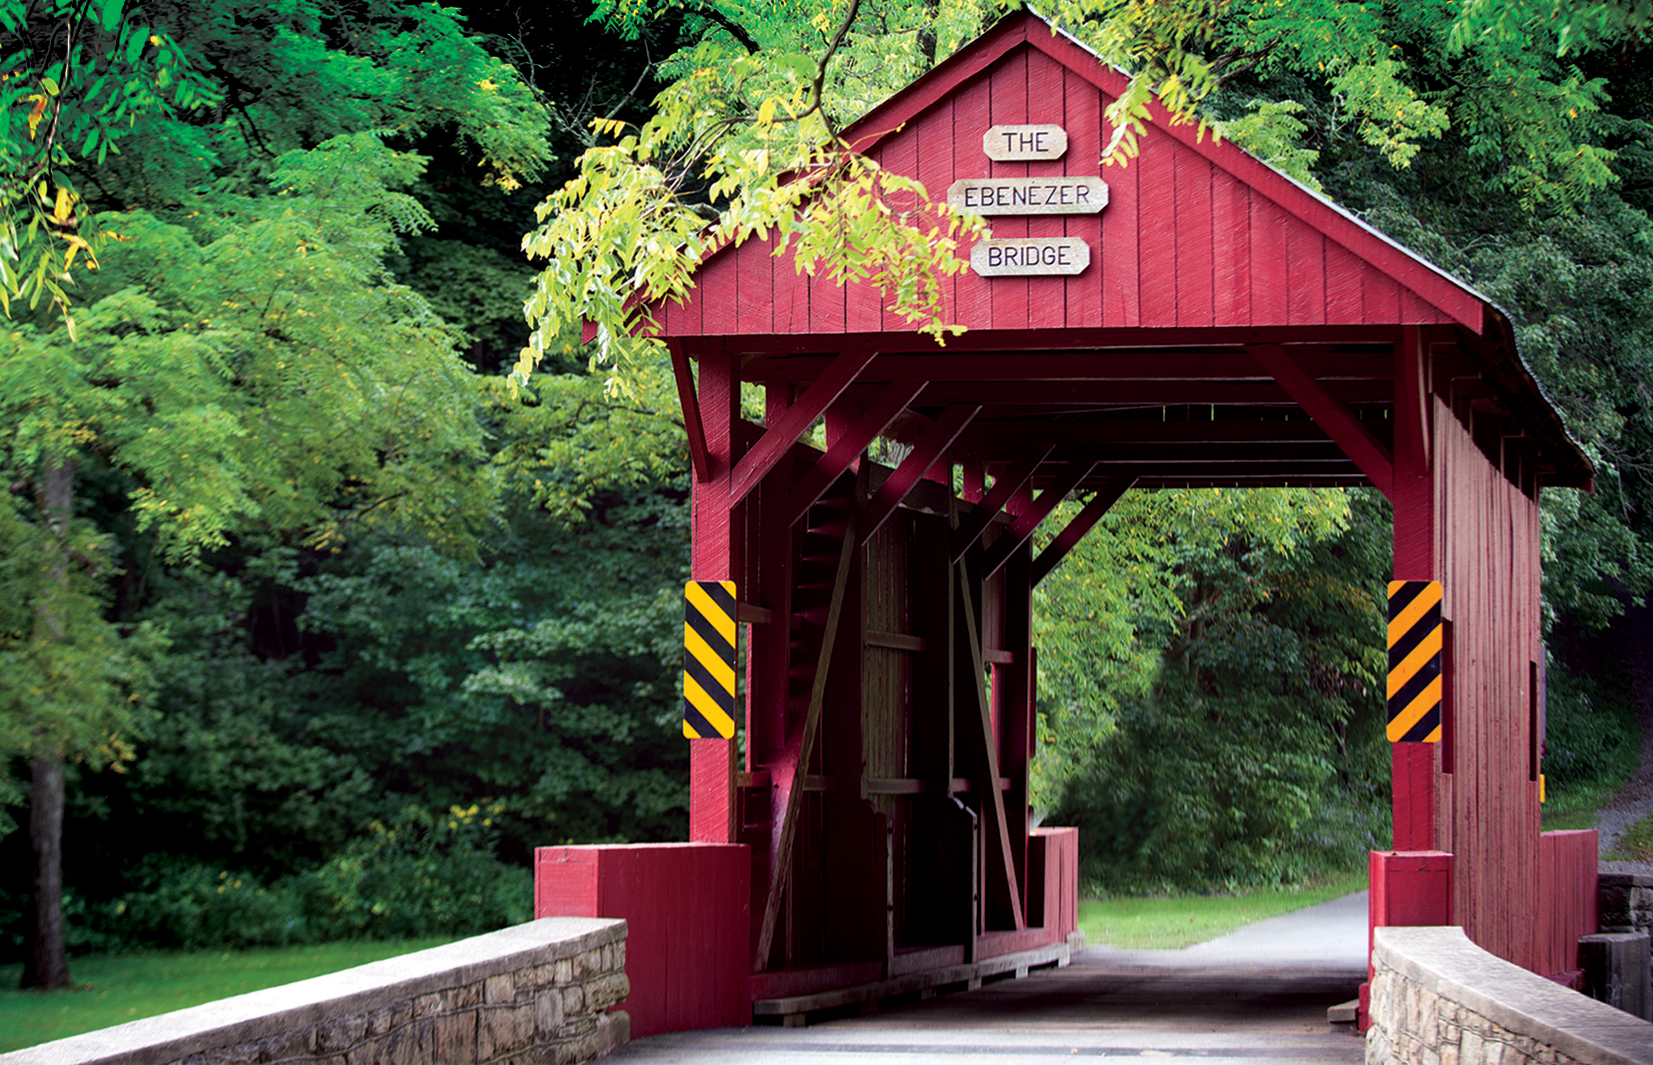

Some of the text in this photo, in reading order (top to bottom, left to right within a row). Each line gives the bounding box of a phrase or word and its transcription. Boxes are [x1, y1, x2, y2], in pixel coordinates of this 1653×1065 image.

[1002, 132, 1049, 152] THE
[965, 185, 1090, 207] EBENEZER
[988, 246, 1071, 267] BRIDGE
